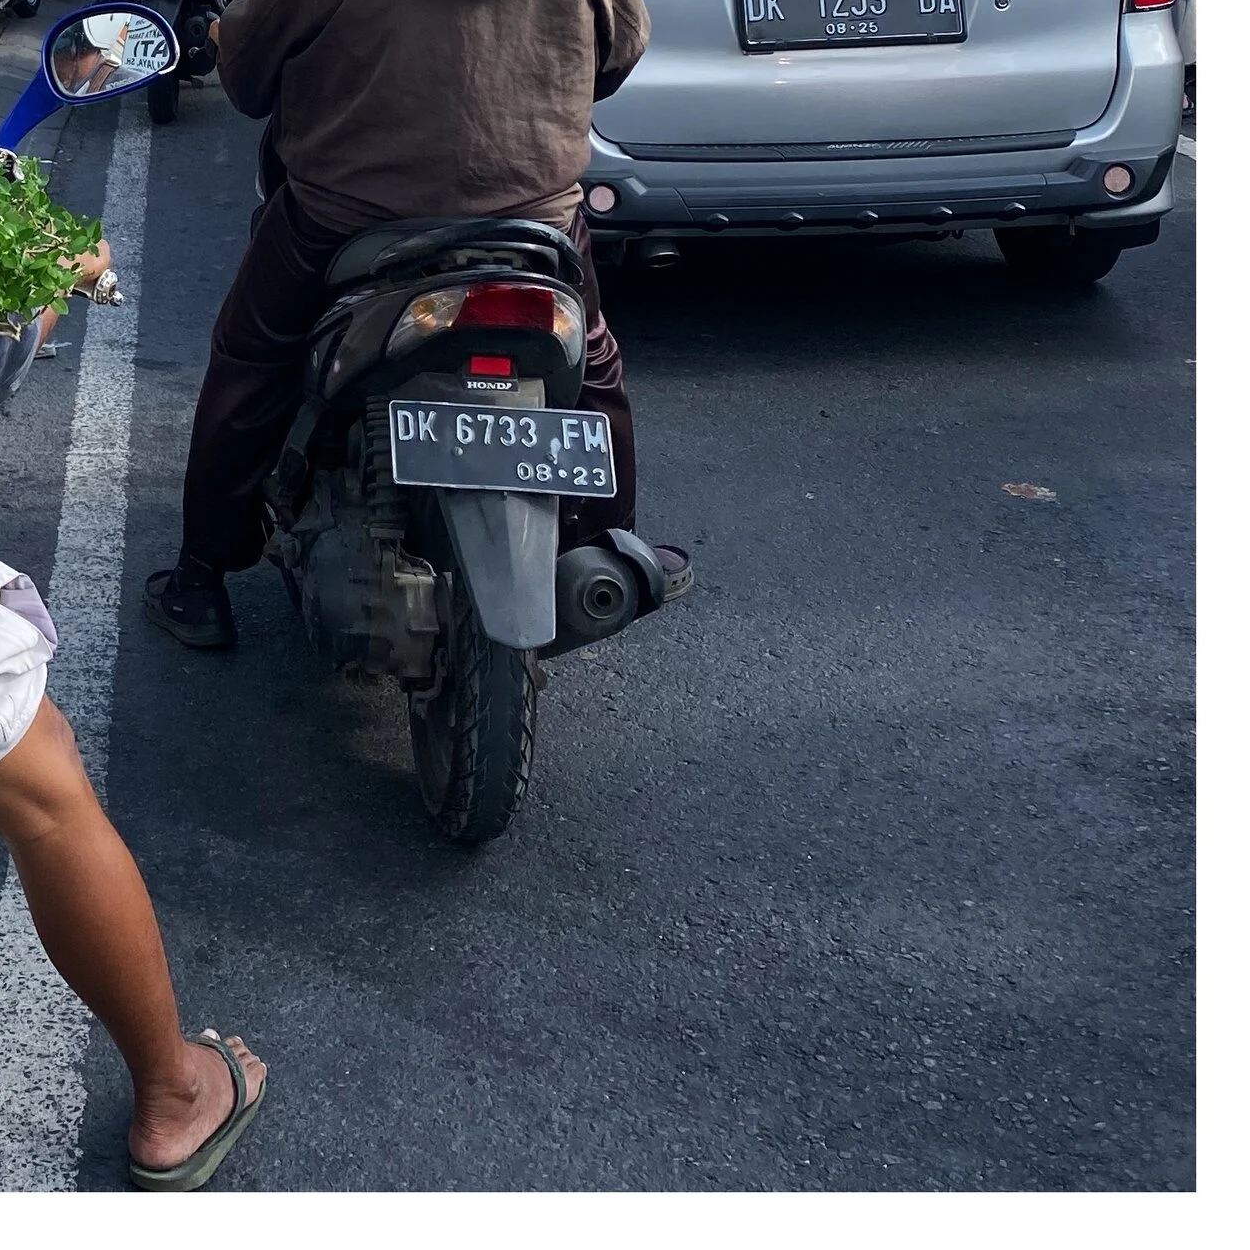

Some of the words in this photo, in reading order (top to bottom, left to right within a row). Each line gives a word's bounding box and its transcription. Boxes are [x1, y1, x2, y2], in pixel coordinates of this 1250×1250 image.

[396, 409, 438, 443] DK
[456, 412, 539, 448] 6733
[561, 417, 607, 453] FM
